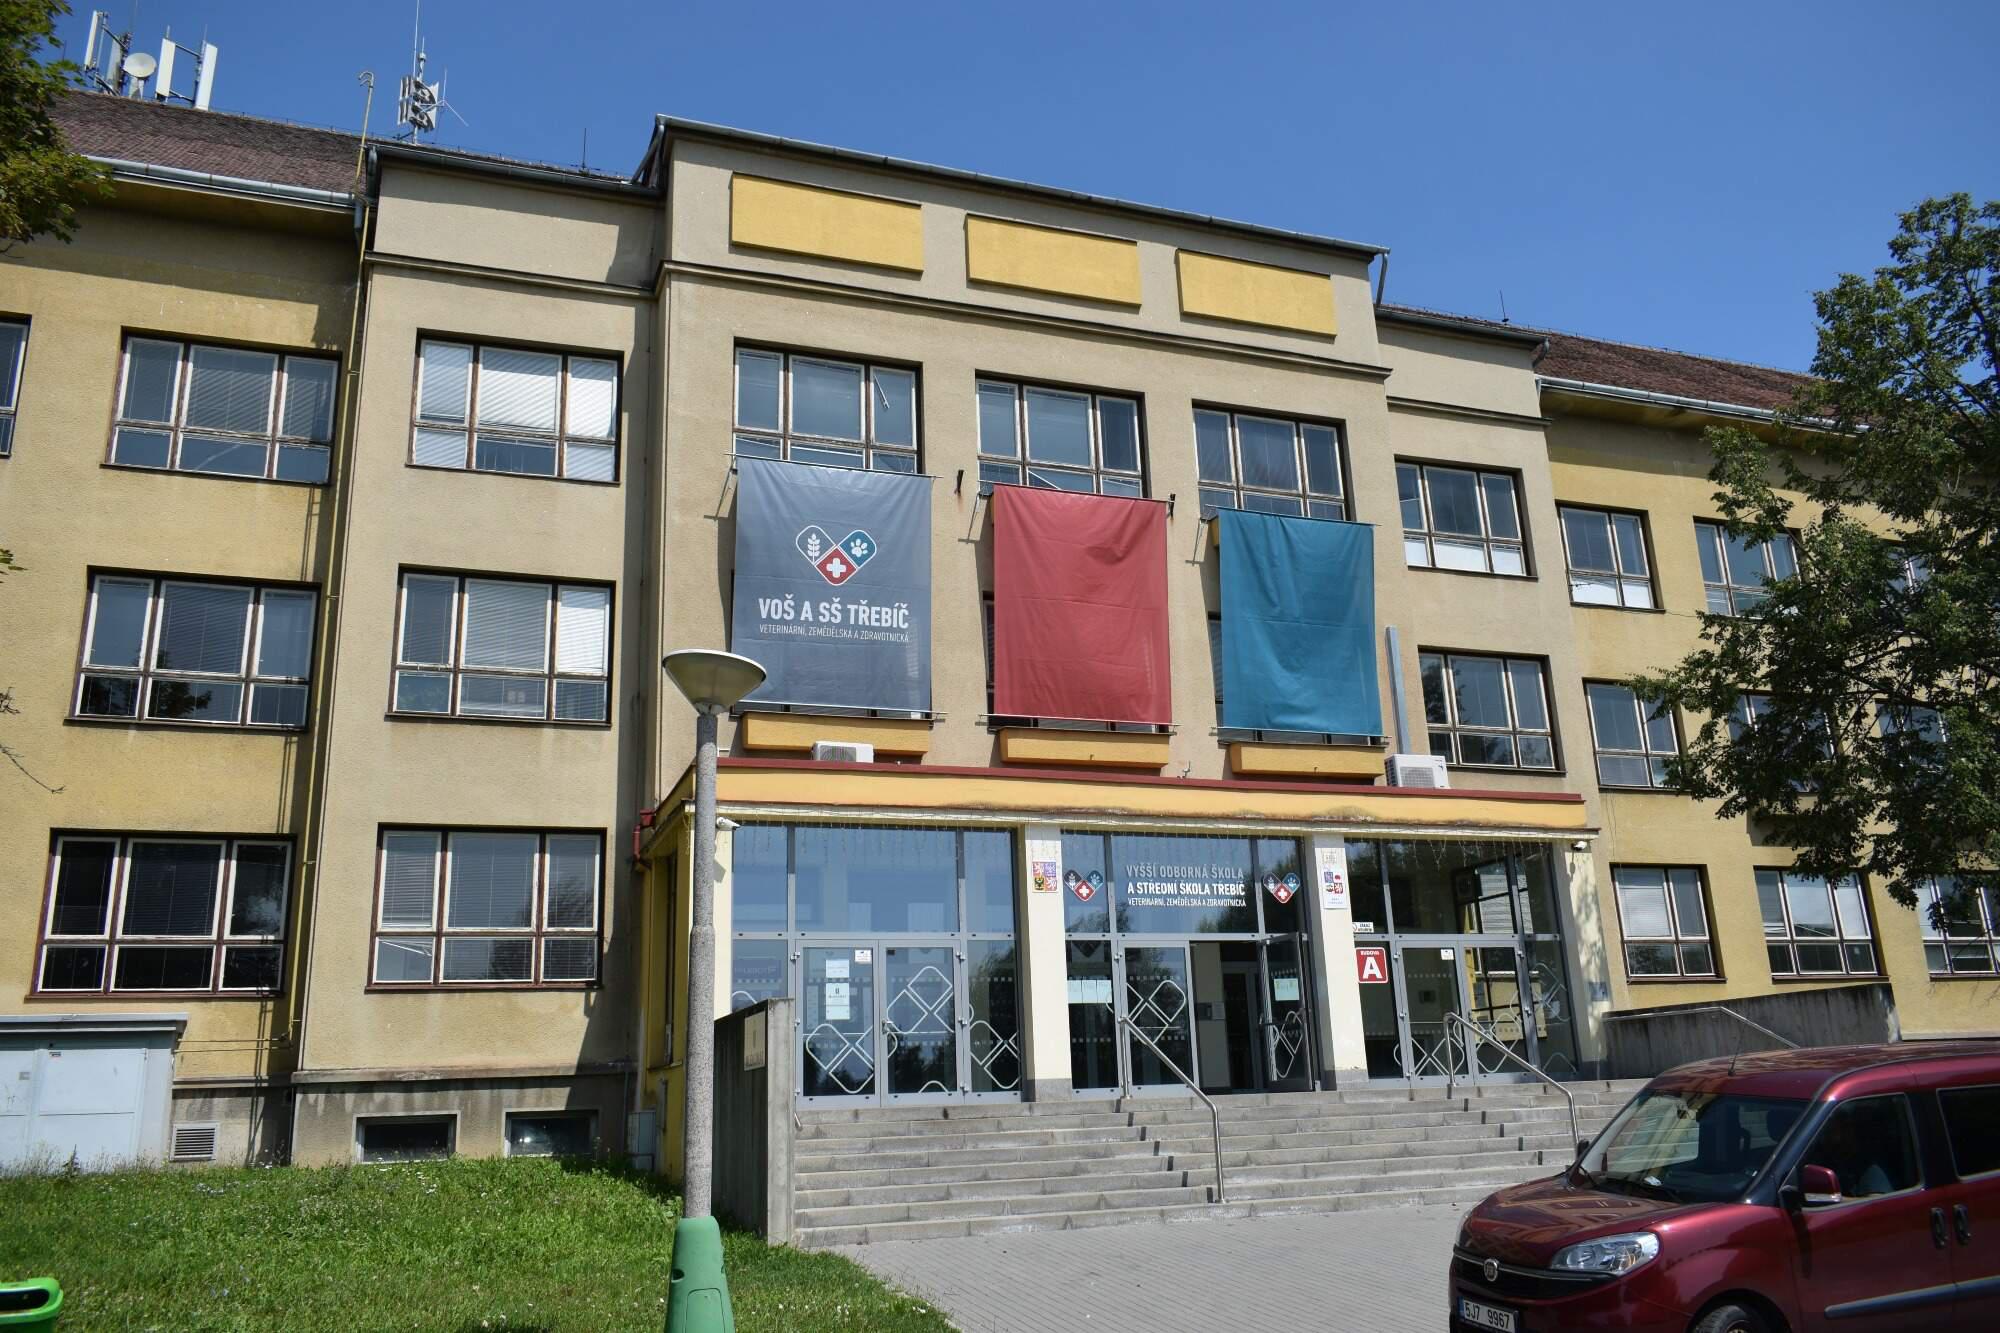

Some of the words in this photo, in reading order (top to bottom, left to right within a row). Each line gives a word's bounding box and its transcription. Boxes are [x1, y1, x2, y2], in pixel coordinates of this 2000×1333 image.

[758, 593, 795, 620] VOŠ
[800, 600, 814, 622] A
[818, 597, 842, 624] SŠ
[847, 599, 909, 629] TŘEBÍČ
[808, 626, 853, 639] ZEMĚDĚLSKÁ
[853, 630, 859, 639] A
[1126, 862, 1156, 878] VYŠŠÍ
[1160, 864, 1209, 879] ODBORNÁ
[1211, 864, 1244, 879] ŠKOLA
[1127, 883, 1135, 895] A
[1137, 880, 1178, 895] STŘEDNÍ
[1180, 880, 1211, 896] ŠKOLA
[1213, 880, 1245, 896] TŘEBÍČ
[1362, 956, 1383, 979] A
[1464, 1301, 1480, 1321] 5J7
[1487, 1309, 1510, 1330] 9967
